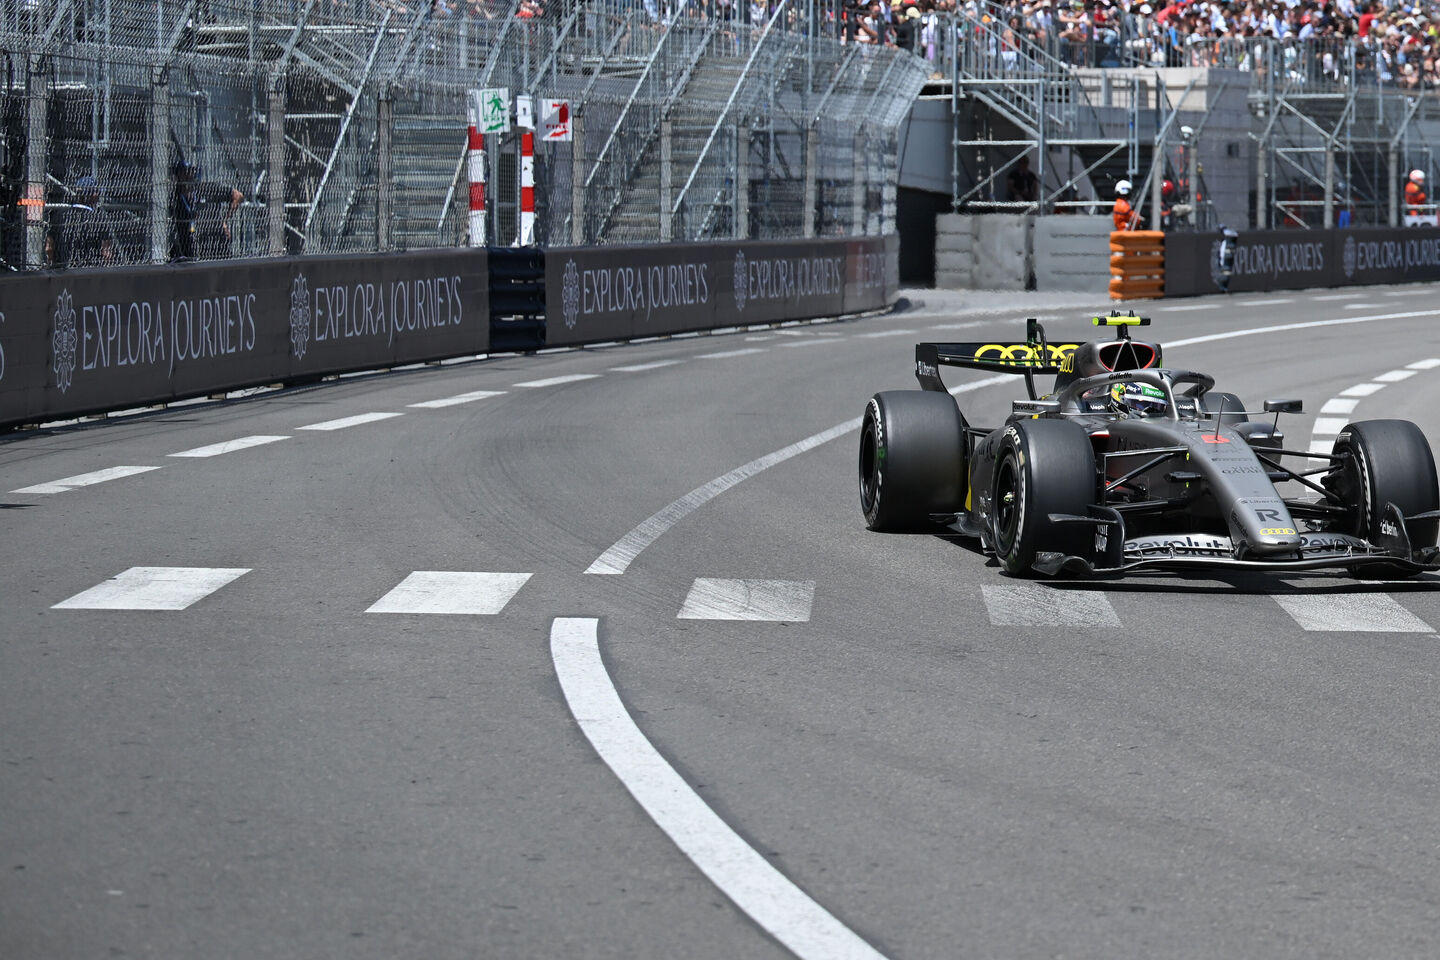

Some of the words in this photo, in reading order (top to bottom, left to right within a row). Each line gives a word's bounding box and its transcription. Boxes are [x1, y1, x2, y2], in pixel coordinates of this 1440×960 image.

[1233, 243, 1272, 275] XPLORA
[1358, 240, 1403, 271] EXPLORA
[583, 267, 645, 314] EXPLORA
[647, 263, 709, 321] JOURNEYS
[750, 258, 796, 300] EXPLORA
[315, 283, 386, 341] EXPLORA
[387, 275, 463, 349] JOURNEYS
[82, 300, 165, 371] EXPLORA
[168, 293, 256, 381] JOURNEYS
[1108, 371, 1133, 381] Gillette
[1254, 508, 1284, 522] R
